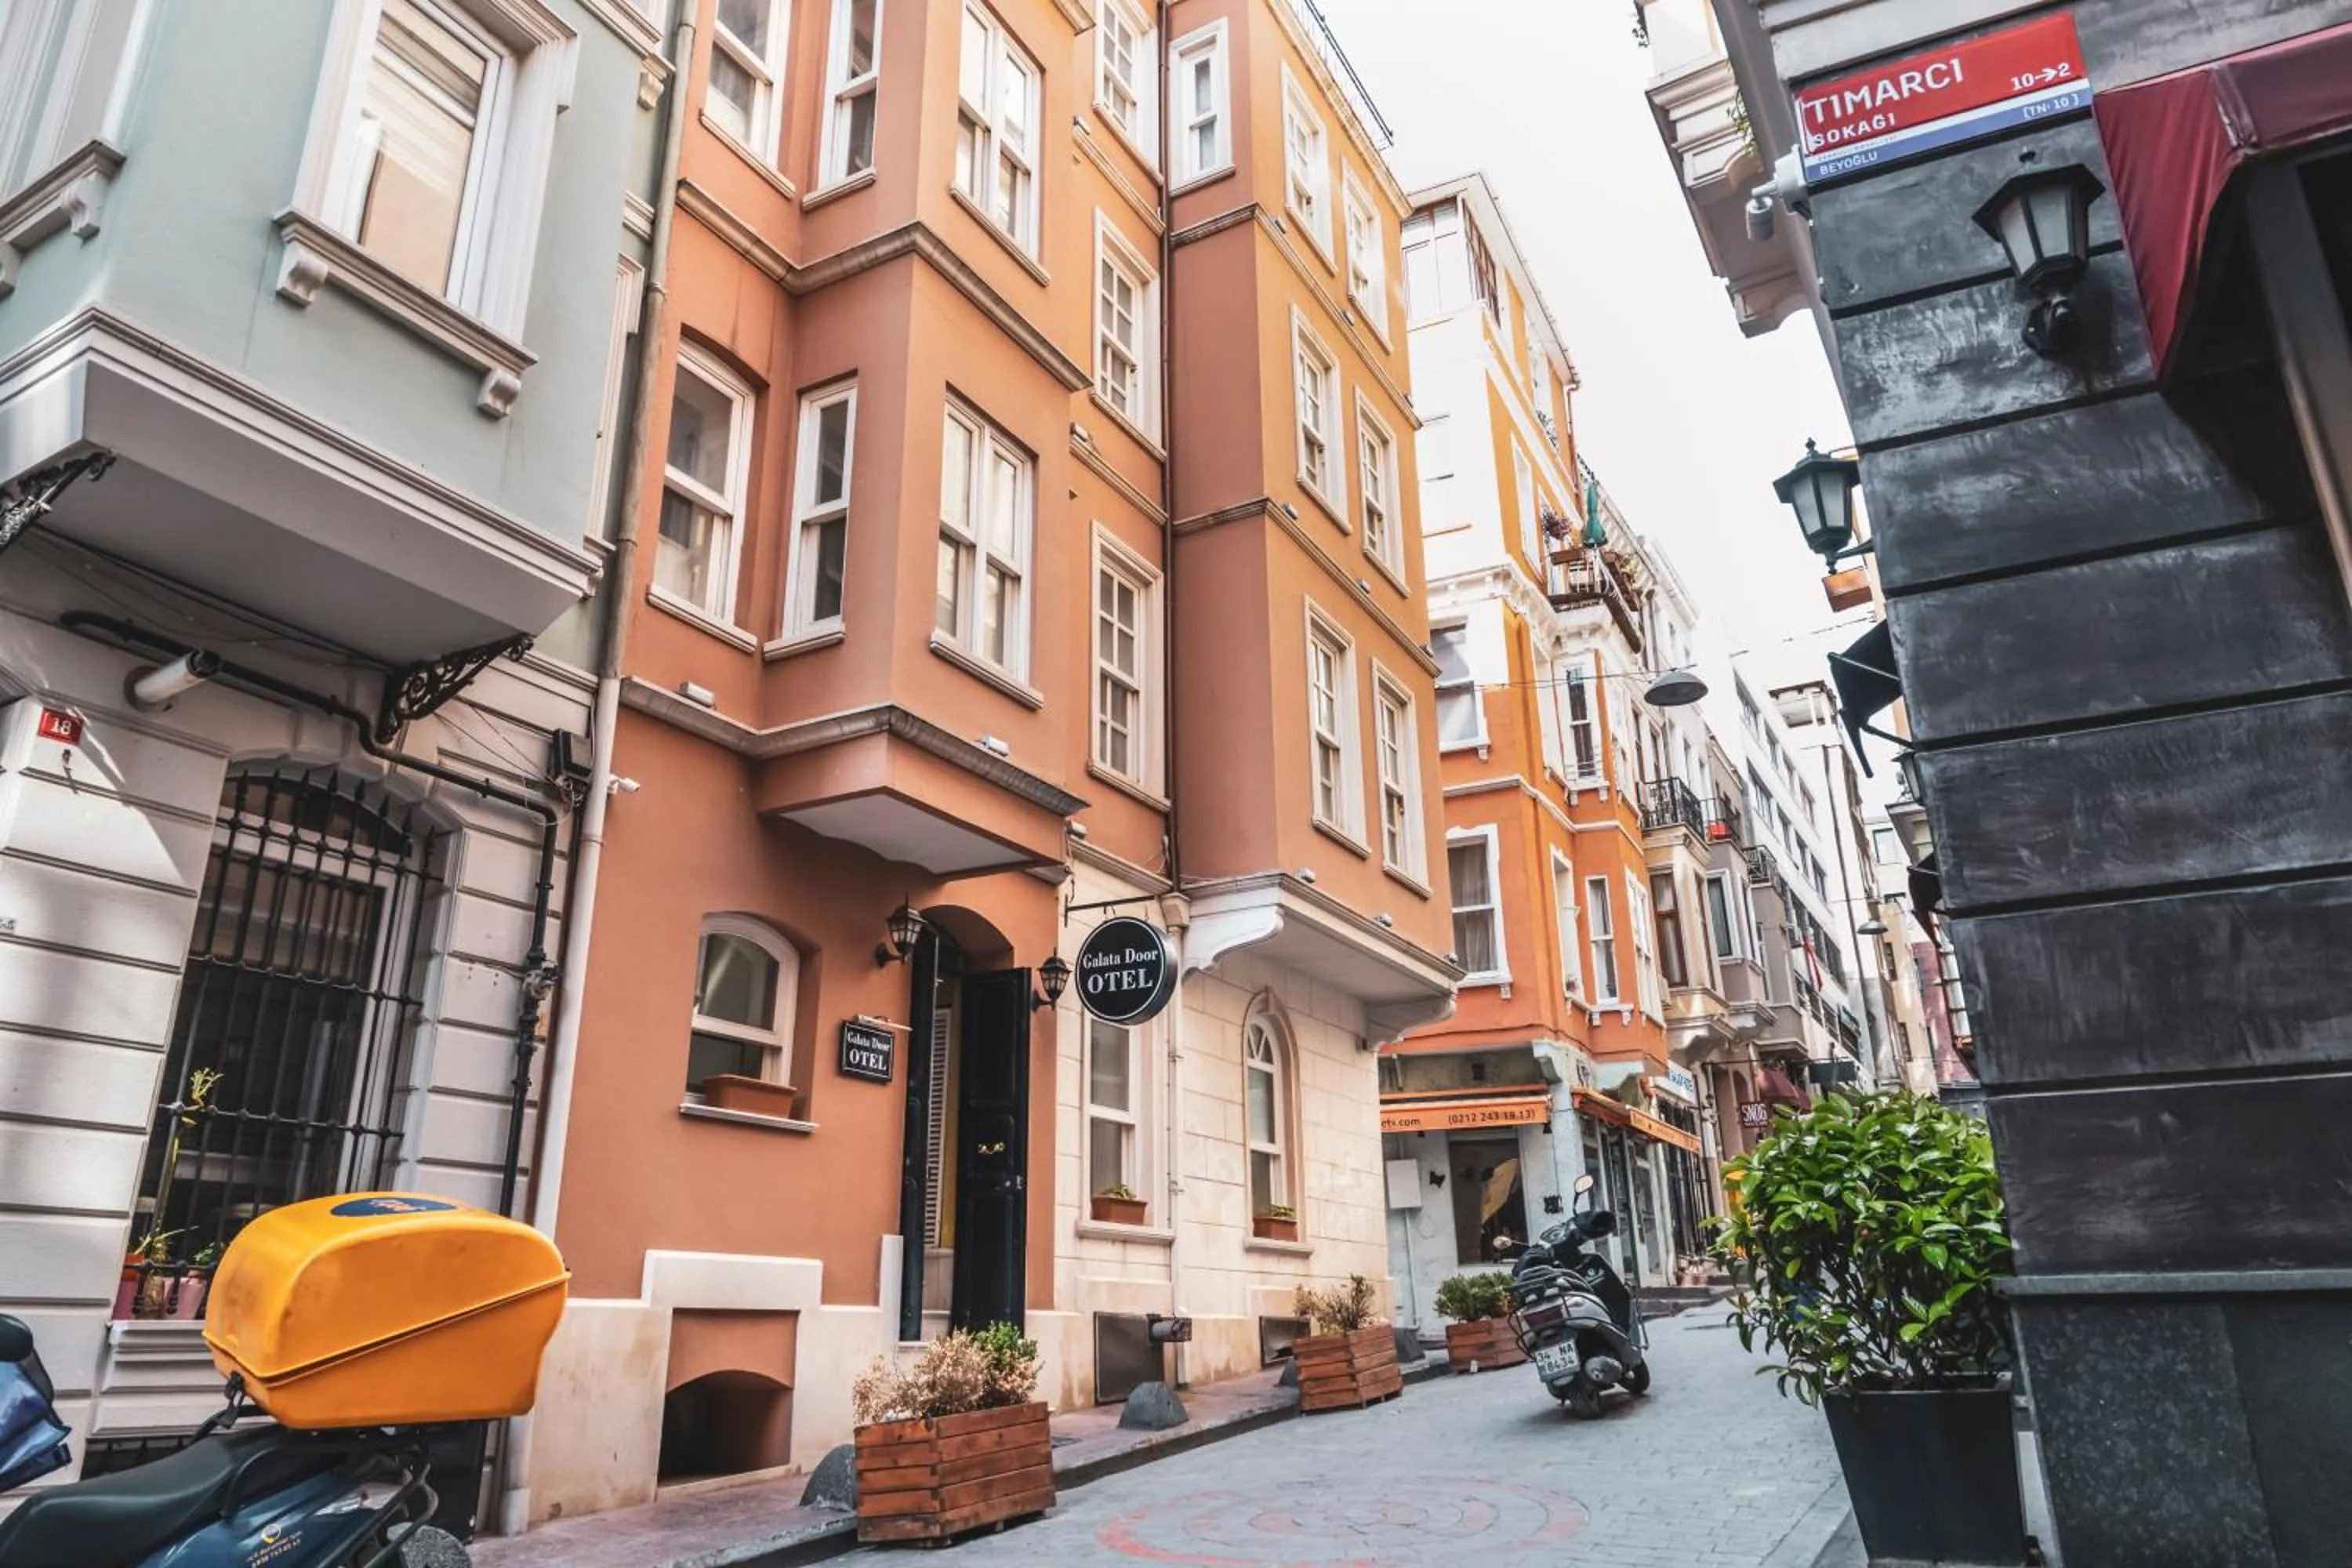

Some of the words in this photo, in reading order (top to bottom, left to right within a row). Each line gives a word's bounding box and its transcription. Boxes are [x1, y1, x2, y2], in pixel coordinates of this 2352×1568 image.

[1804, 58, 1963, 124] TIMARCI
[1813, 112, 1896, 147] SOKAĞI
[50, 717, 71, 735] 18
[1083, 952, 1121, 969] Galata
[1125, 948, 1158, 964] Door
[1087, 968, 1153, 994] OTEL
[848, 1032, 870, 1047] Galata
[871, 1037, 890, 1051] Door
[849, 1048, 887, 1070] OTEL
